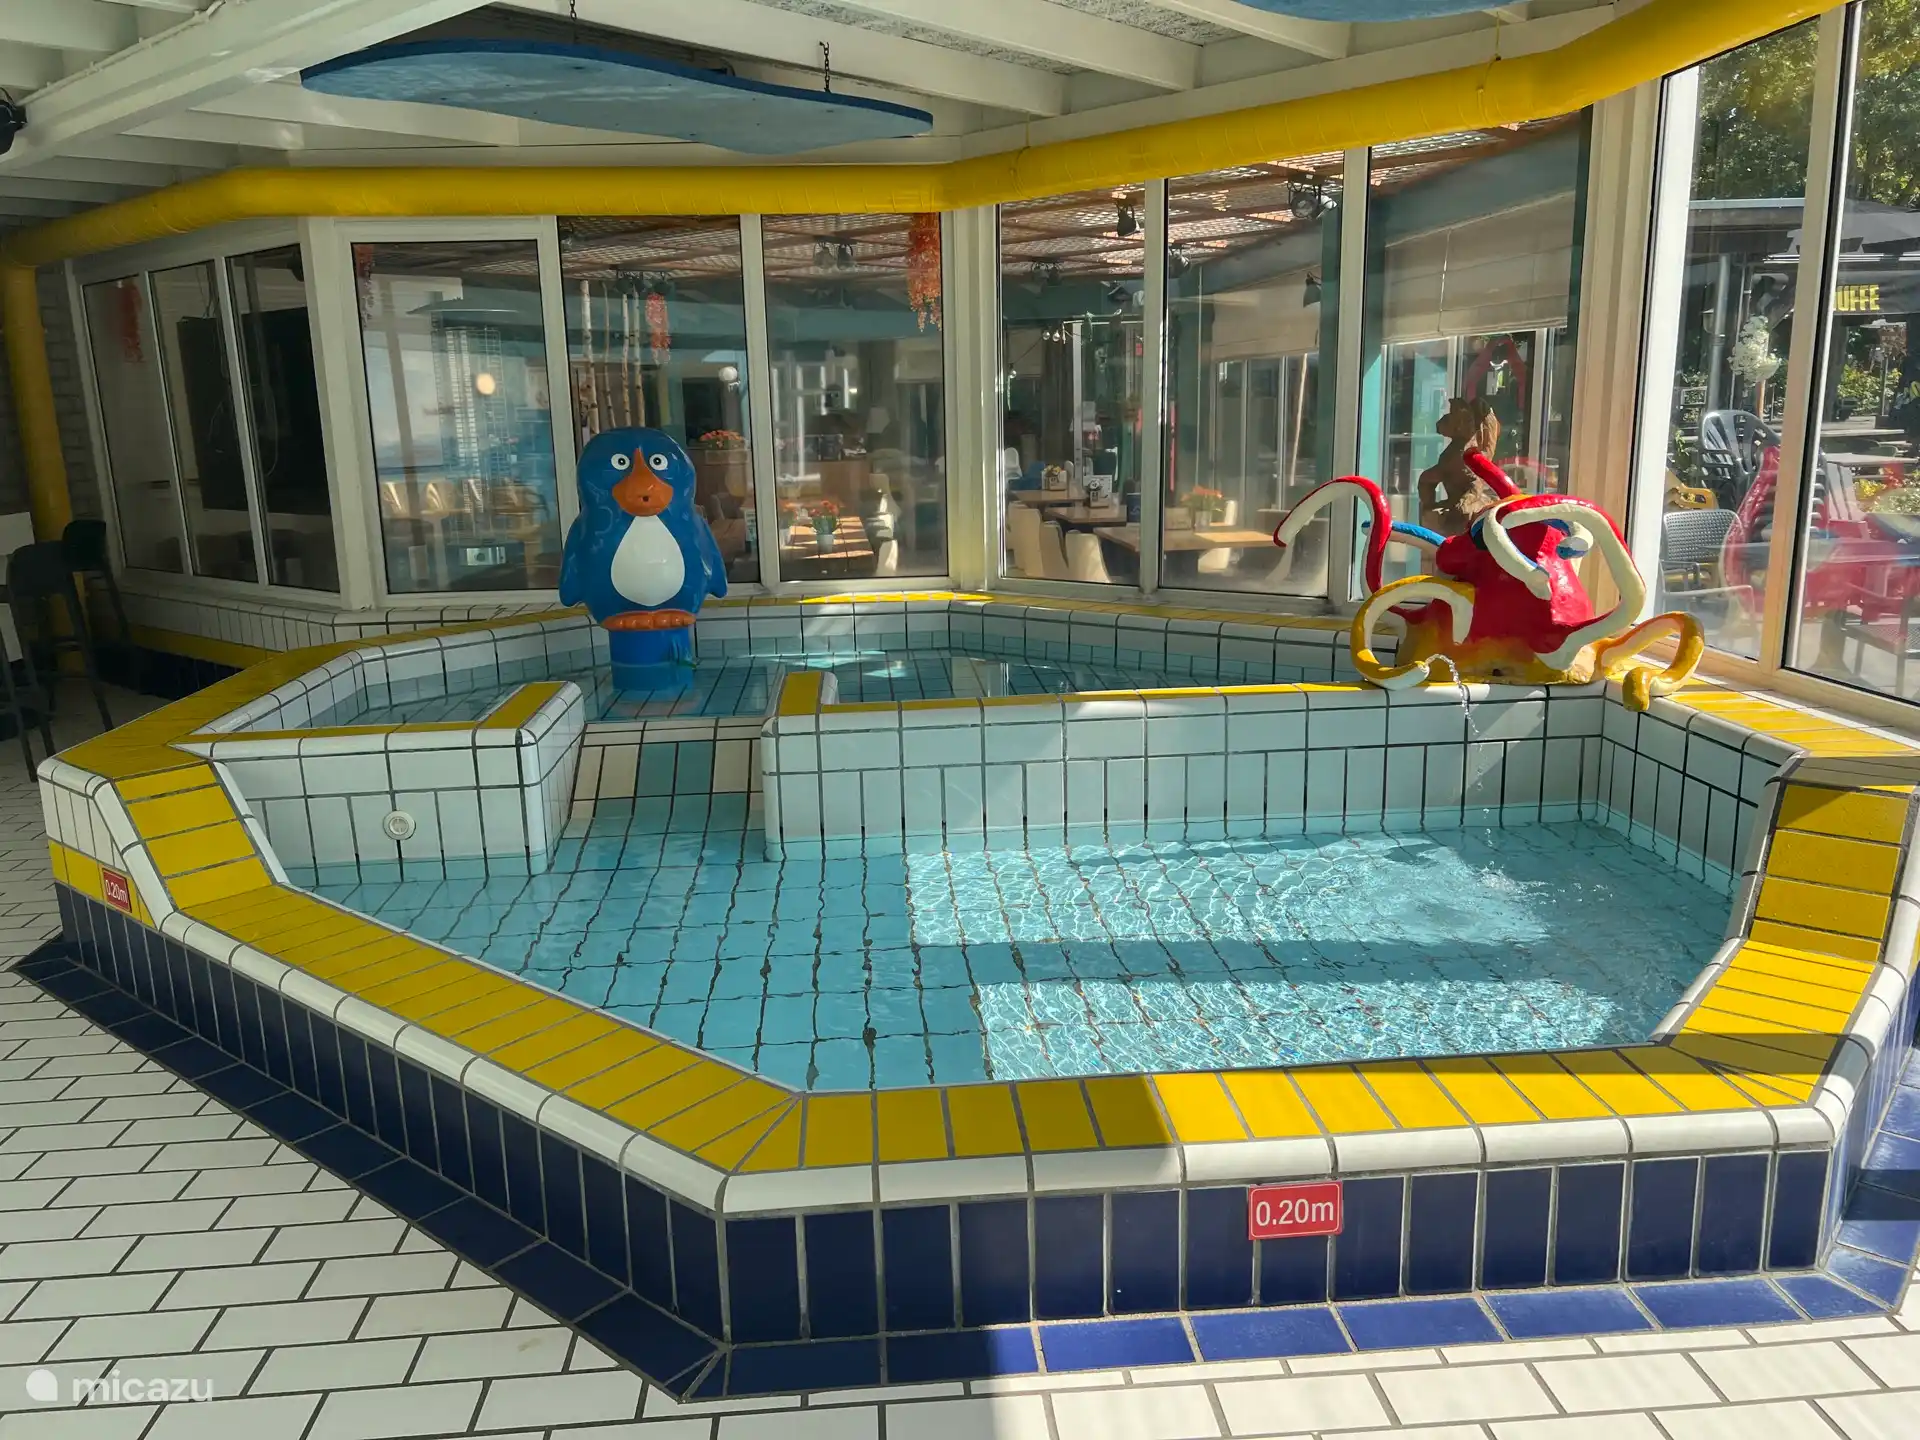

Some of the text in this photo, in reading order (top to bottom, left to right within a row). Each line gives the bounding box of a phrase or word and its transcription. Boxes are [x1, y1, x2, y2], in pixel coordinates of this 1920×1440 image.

[1833, 284, 1880, 312] UFFE
[105, 879, 128, 904] 0.20m
[1255, 1198, 1334, 1227] 0.20m
